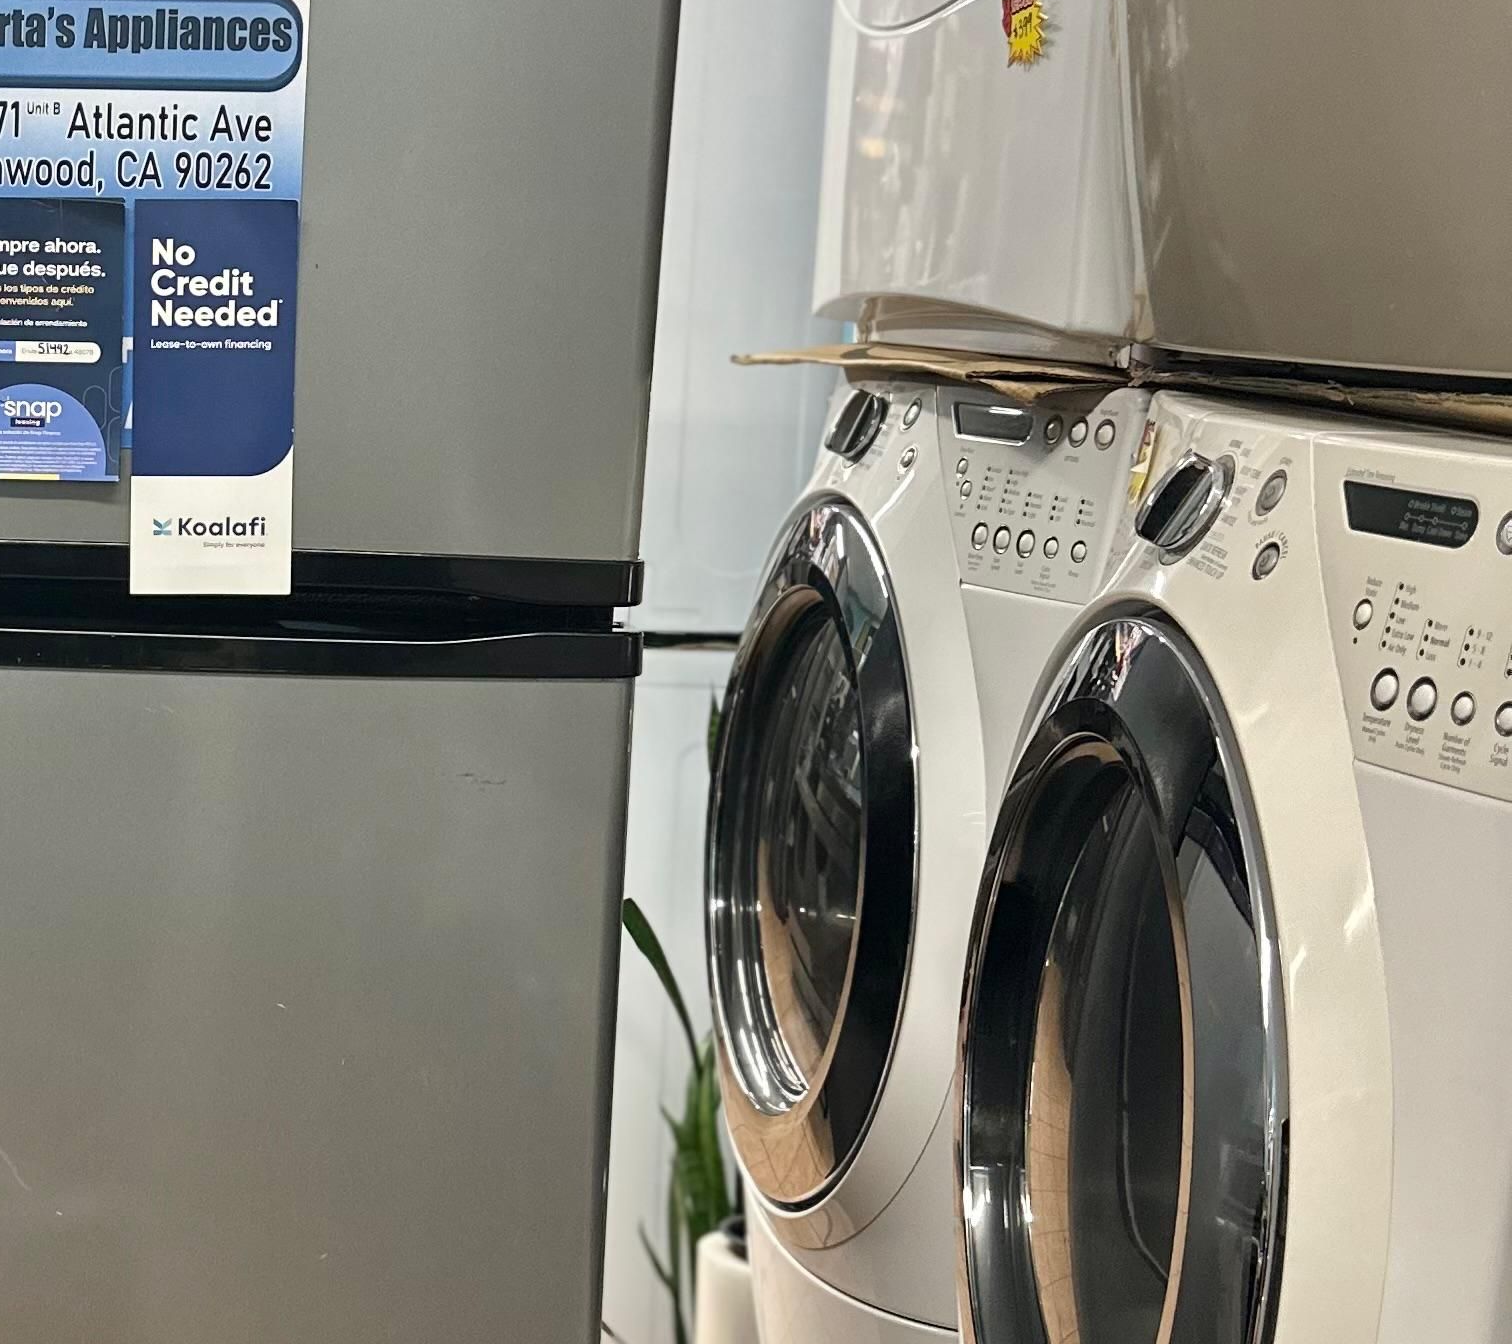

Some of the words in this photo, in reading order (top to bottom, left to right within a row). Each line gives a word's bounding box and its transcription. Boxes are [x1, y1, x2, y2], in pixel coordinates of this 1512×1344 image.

[83, 8, 292, 54] Appliances
[27, 102, 50, 115] Unit
[52, 102, 61, 116] B
[67, 102, 199, 141] Atlantic
[210, 105, 272, 142] Ave
[117, 150, 162, 189] CA
[175, 152, 272, 190] 90262
[44, 238, 102, 254] ahora.
[152, 238, 196, 266] No
[23, 260, 106, 280] después.
[151, 268, 253, 296] Credit
[3, 283, 19, 293] los
[20, 283, 44, 295] tipos
[46, 284, 59, 294] de
[61, 284, 95, 295] crédito
[151, 299, 281, 327] Needed
[150, 339, 223, 349] Lease-to-own
[224, 339, 272, 351] financing
[3, 399, 63, 423] snap
[14, 418, 41, 427] leasing
[178, 516, 266, 536] Koalafi
